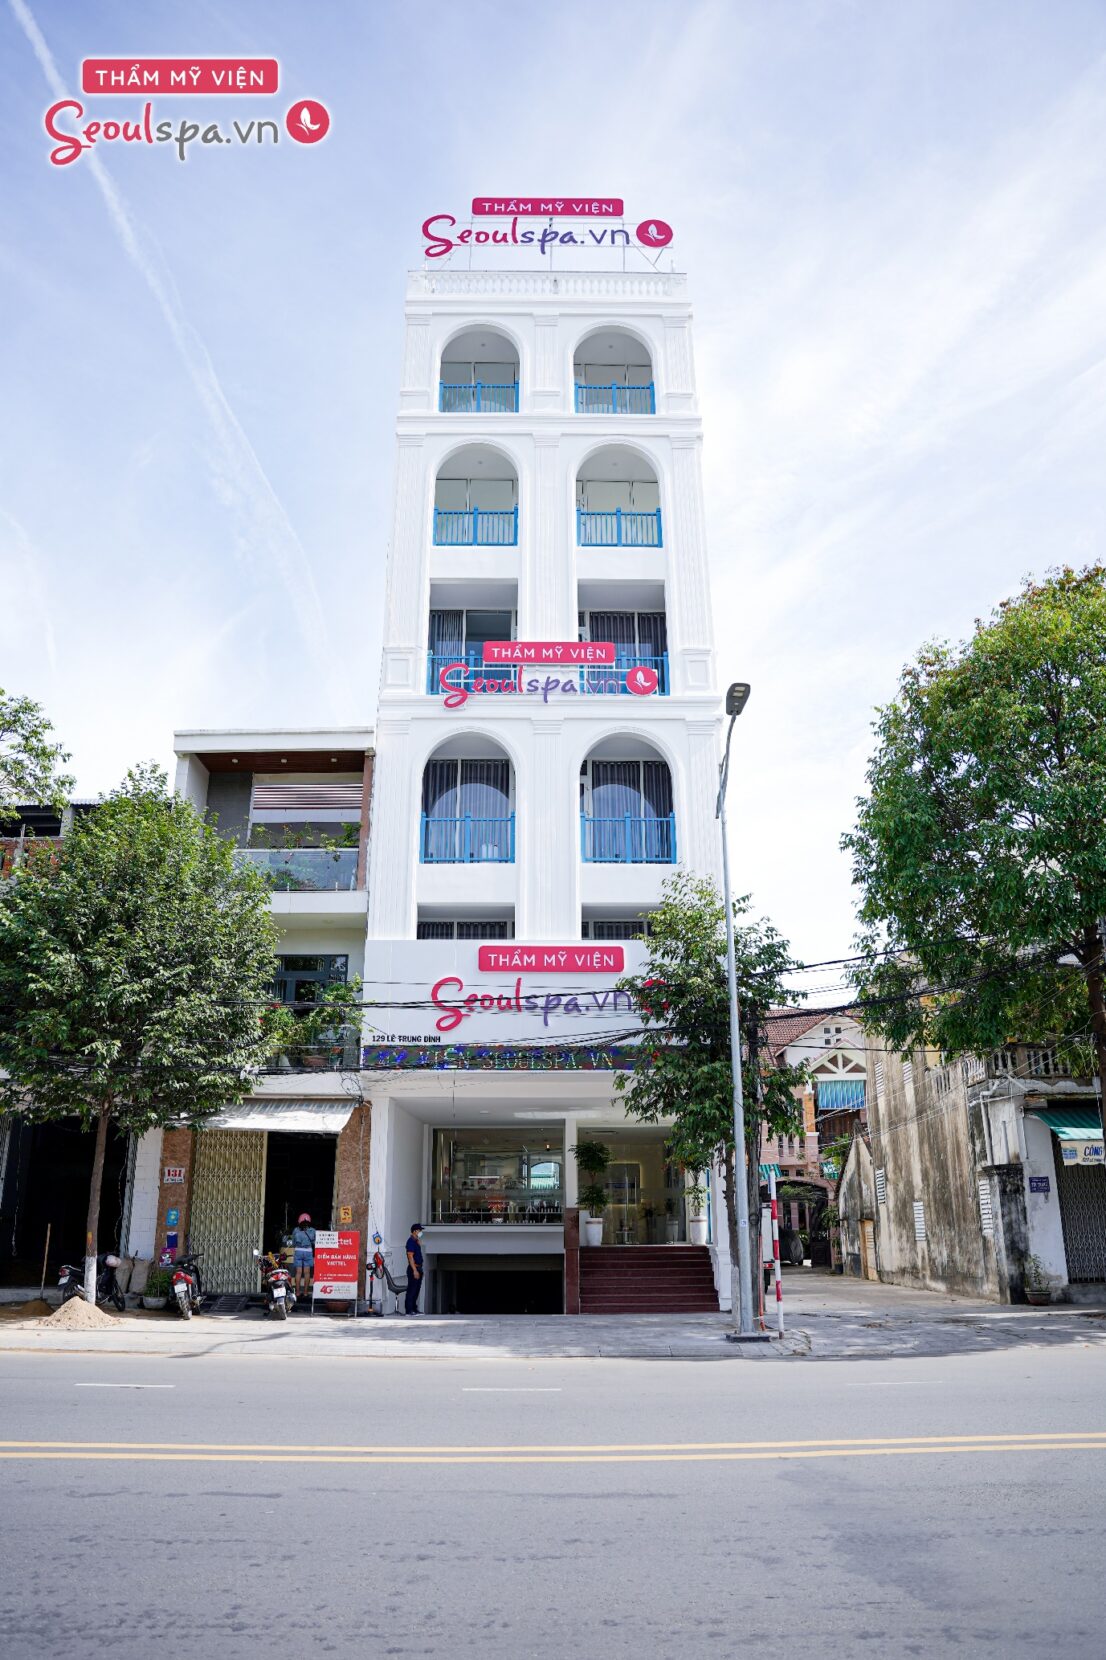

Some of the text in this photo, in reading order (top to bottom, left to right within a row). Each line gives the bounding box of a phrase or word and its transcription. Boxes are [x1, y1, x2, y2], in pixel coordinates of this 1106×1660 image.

[482, 199, 614, 214] THẨM MỸ VIỆN
[421, 213, 630, 258] Seoulspa.vn
[491, 643, 606, 661] THẨM MỸ VIỆN
[439, 662, 621, 709] Seoulspa.vn
[488, 949, 615, 969] THẨM MỸ VIỆN
[430, 976, 632, 1032] Seoulspa.vn
[372, 1035, 386, 1043] 129
[387, 1034, 396, 1043] LÊ
[397, 1035, 422, 1043] TRUNG
[167, 1169, 182, 1178] 131
[320, 1284, 334, 1295] 4G
